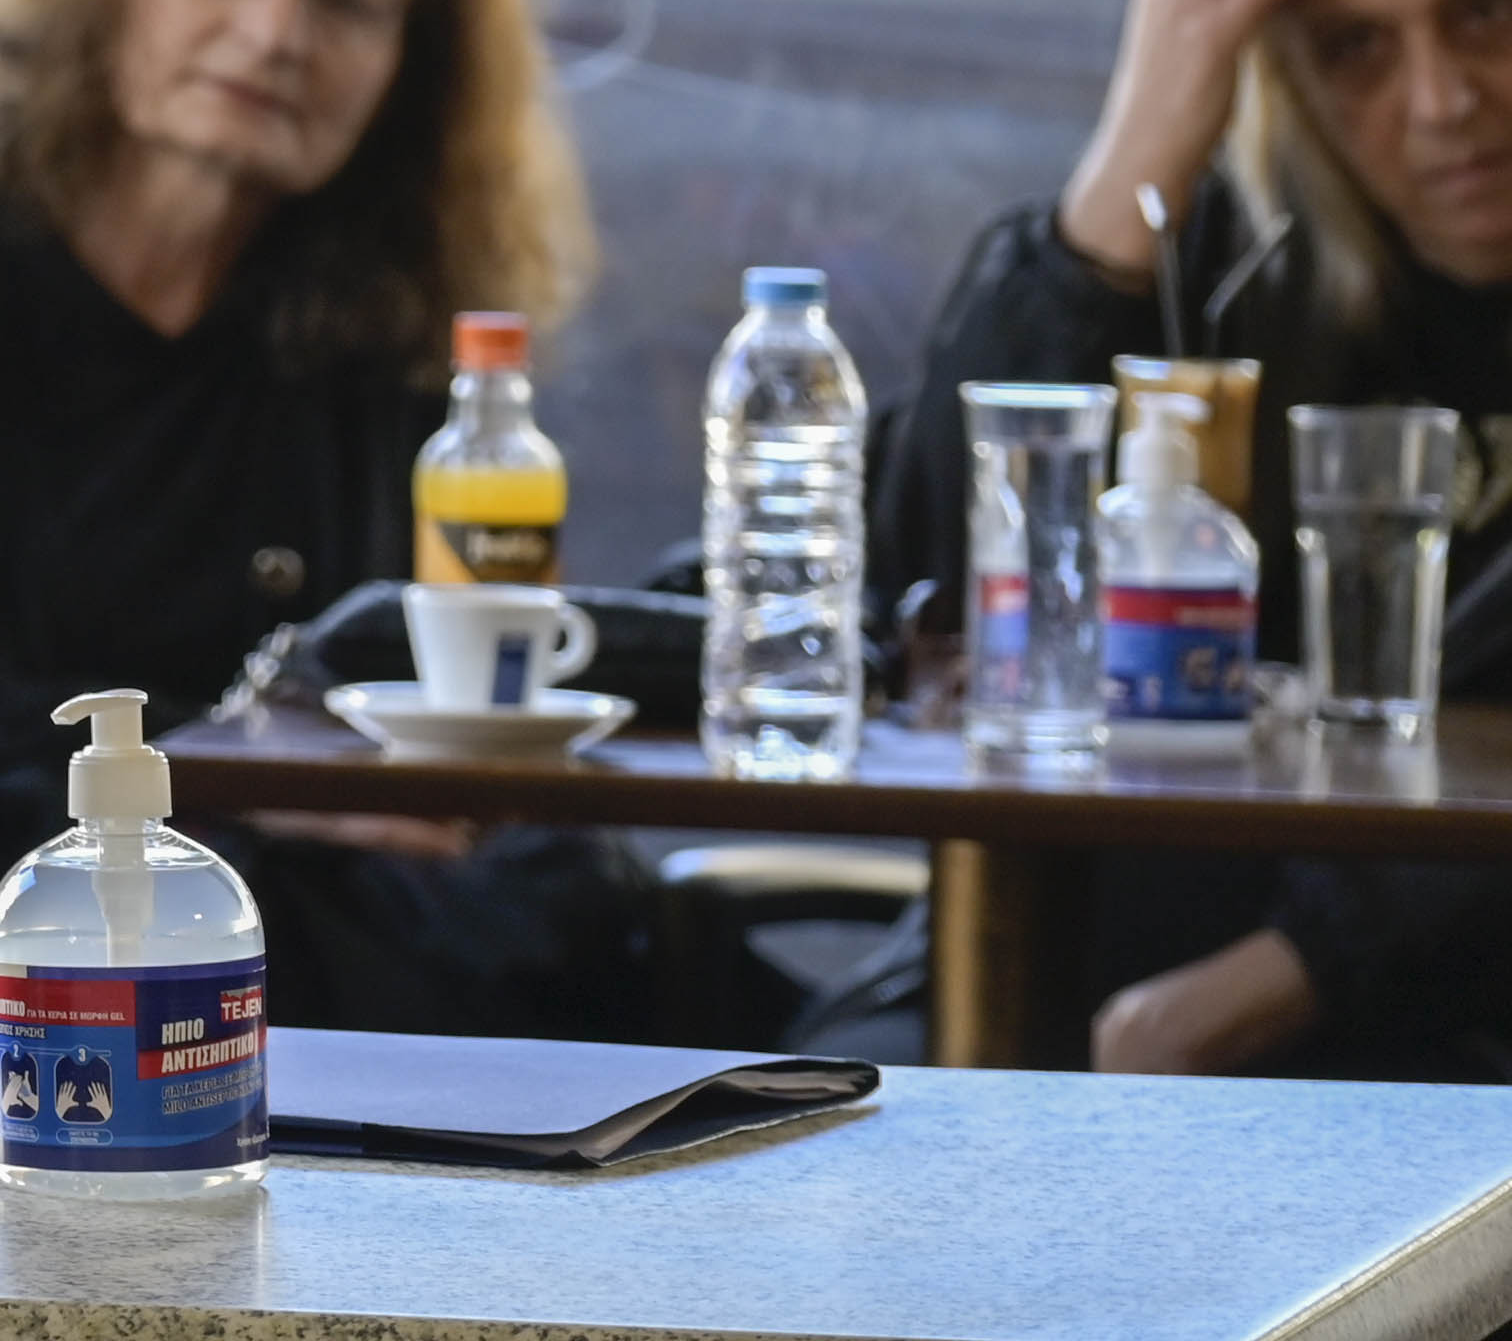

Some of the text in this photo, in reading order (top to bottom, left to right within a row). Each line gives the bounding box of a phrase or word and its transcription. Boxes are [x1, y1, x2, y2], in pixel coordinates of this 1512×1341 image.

[110, 1013, 126, 1021] GEL
[220, 997, 262, 1021] TEJEN
[161, 1017, 205, 1046] ΗΠΙΟ
[13, 1044, 19, 1058] 2
[78, 1048, 86, 1062] 3
[161, 1031, 255, 1074] ΑΝΤΙΣΗΠΤΙΚΟ
